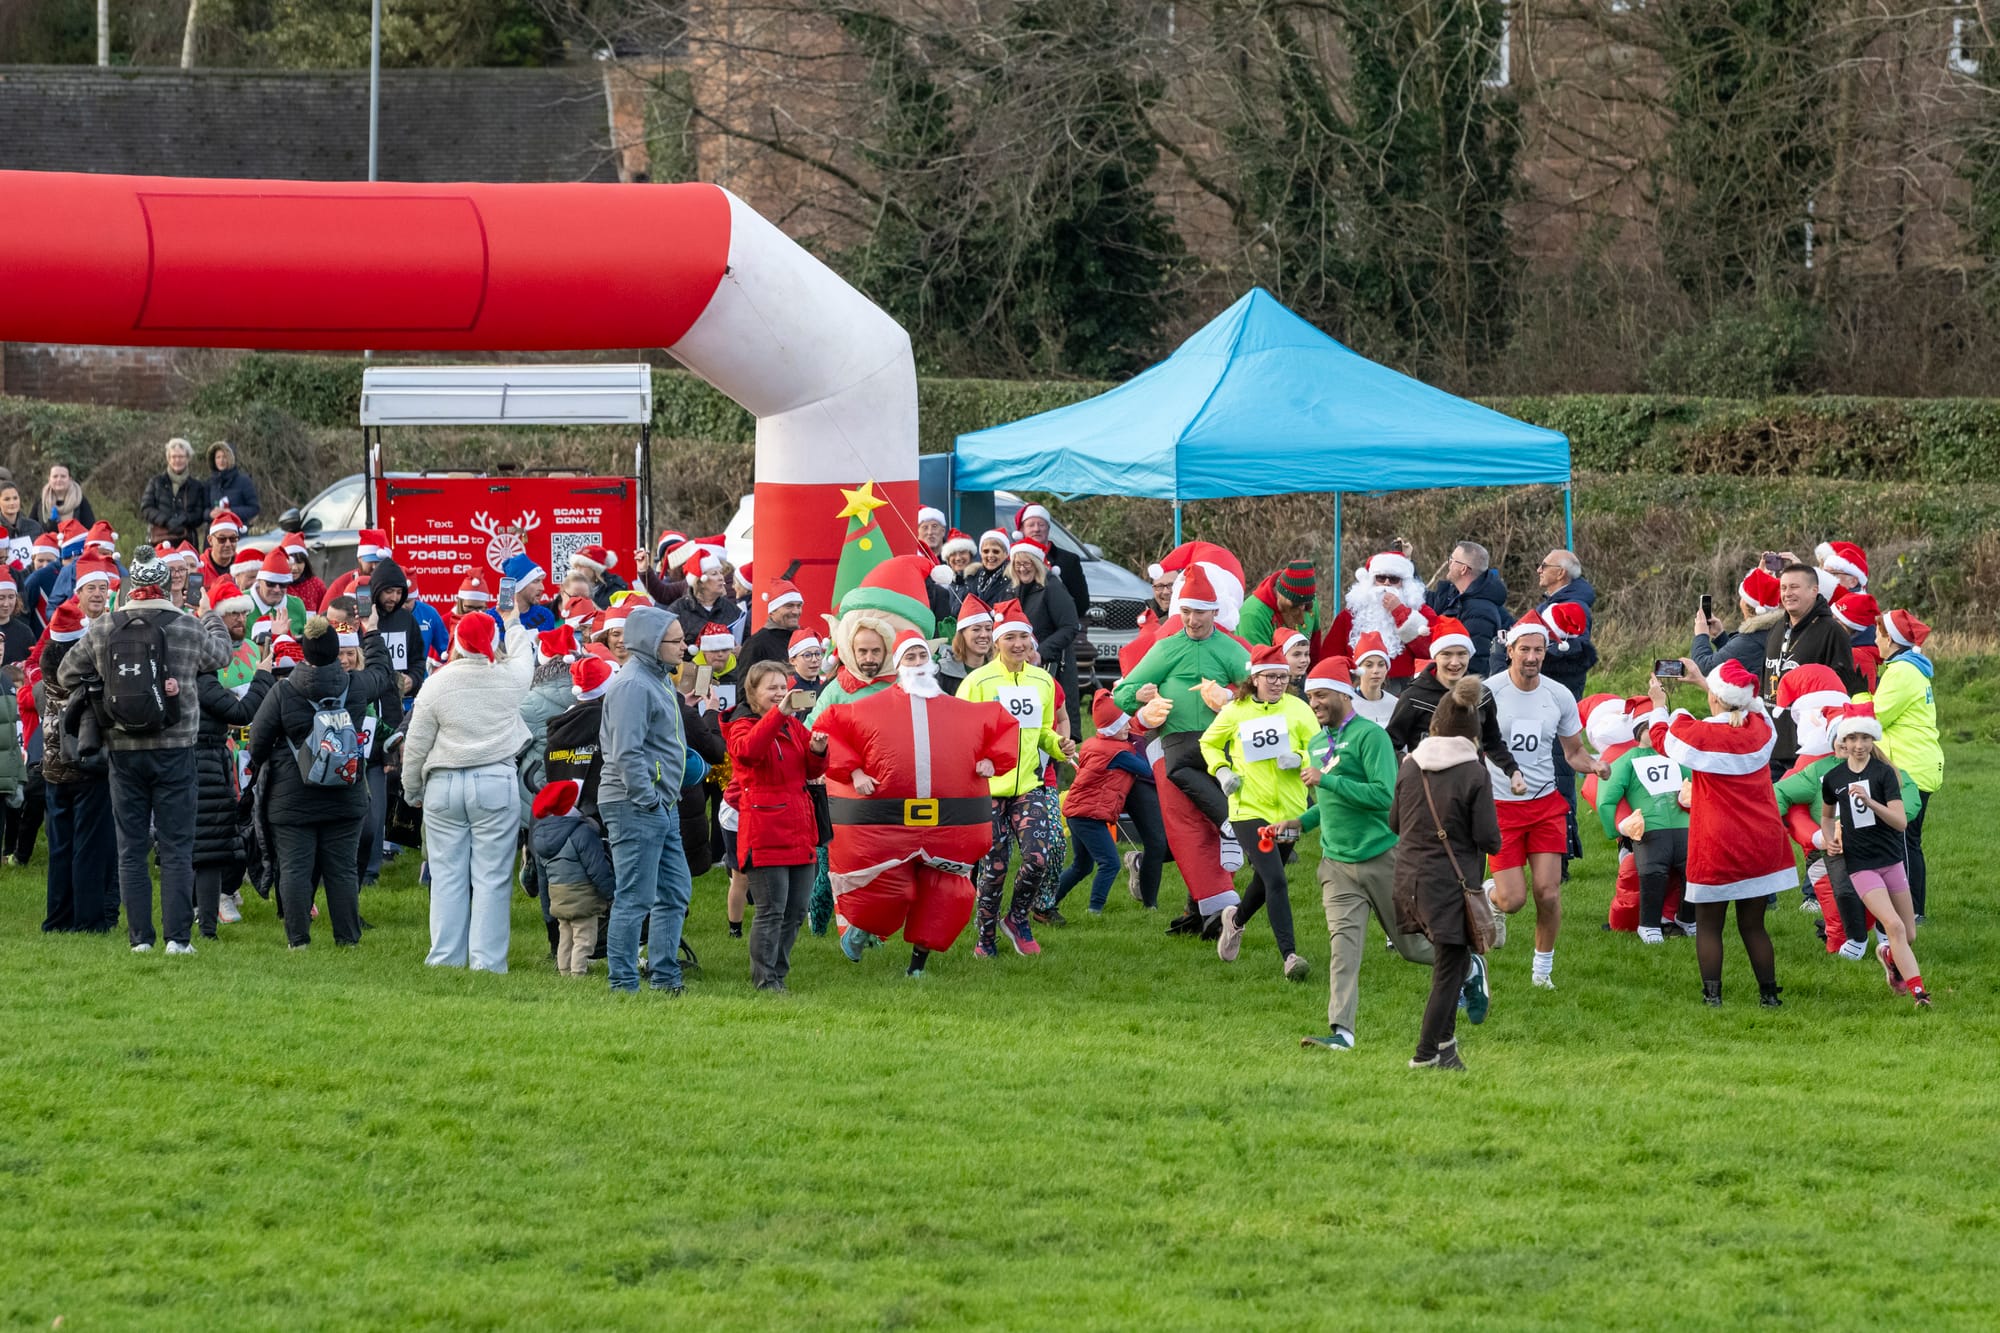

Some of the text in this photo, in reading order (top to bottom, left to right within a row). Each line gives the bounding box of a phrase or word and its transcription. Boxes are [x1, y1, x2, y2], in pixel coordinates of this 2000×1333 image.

[553, 508, 602, 516] SCAN TO
[426, 519, 454, 529] Text
[555, 516, 600, 524] DONATE
[395, 534, 485, 545] LICHFIELD to
[12, 546, 30, 560] 33
[408, 550, 472, 560] 70480 to
[414, 565, 450, 575] onate
[1010, 698, 1034, 716] 95
[1252, 728, 1280, 748] 58
[1511, 733, 1538, 752] 20
[1647, 764, 1669, 782] 67
